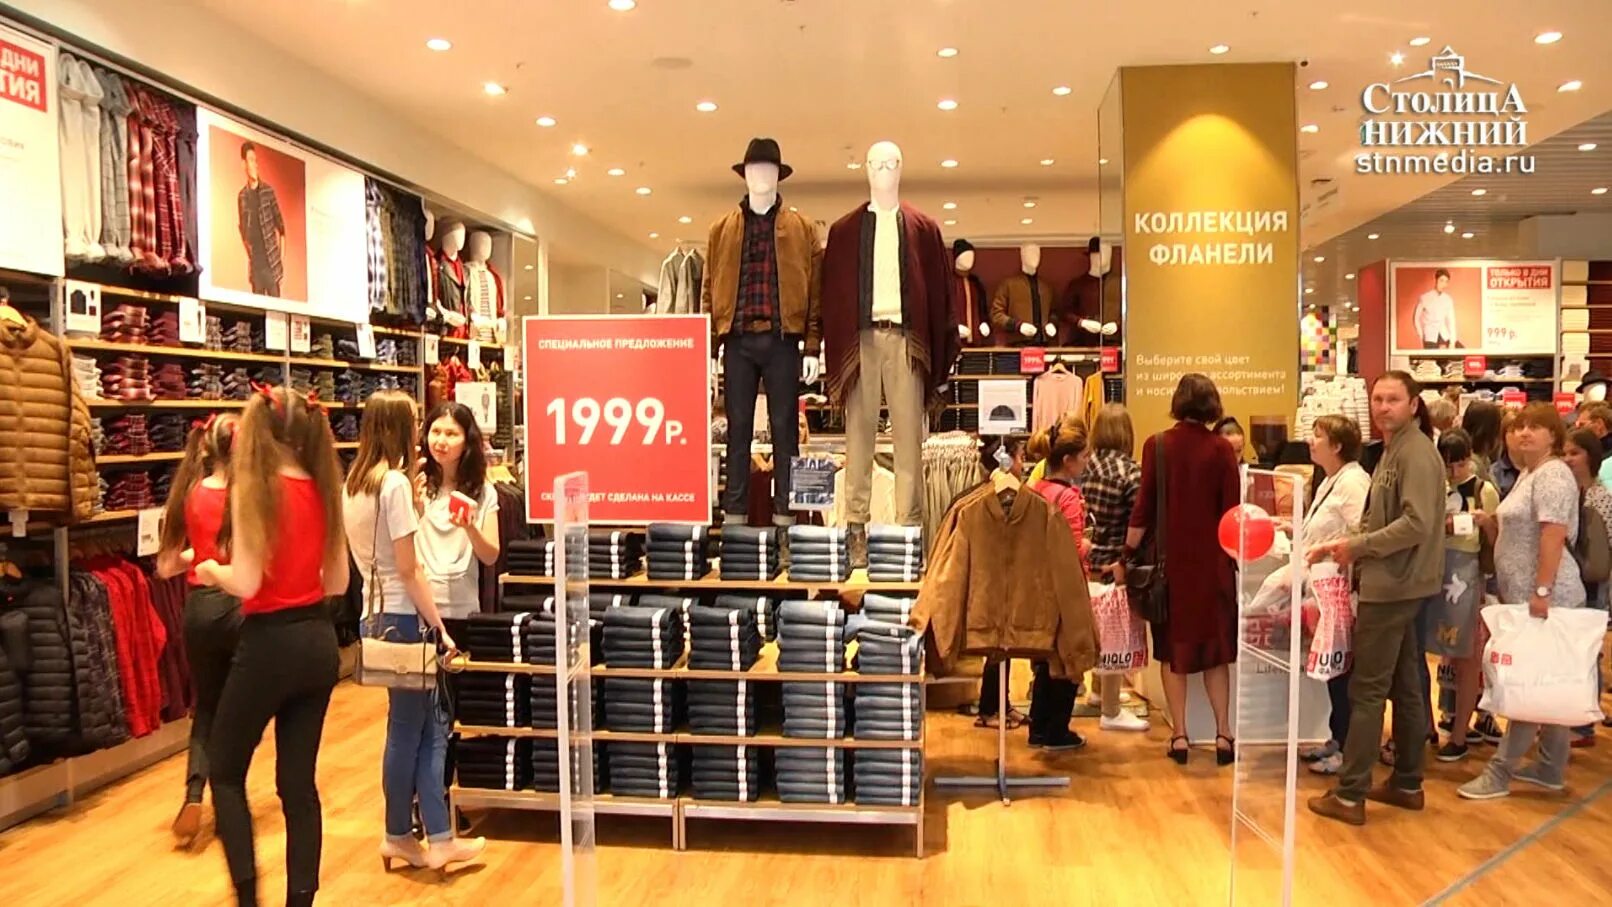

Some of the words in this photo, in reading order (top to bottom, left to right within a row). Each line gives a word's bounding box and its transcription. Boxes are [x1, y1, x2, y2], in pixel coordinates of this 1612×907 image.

[1, 47, 39, 77] ДНИ
[1135, 211, 1288, 236] КОЛЛЕКЦИЯ
[1149, 243, 1274, 266] ФЛАНЕЛИ
[1490, 277, 1549, 288] ОТКРЫТИЯ
[538, 338, 612, 350] СПЕЦИАЛЬНОЕ
[615, 338, 694, 350] ПРЕДЛОЖЕНИЕ
[1136, 354, 1192, 367] Выберите
[1195, 354, 1221, 365] свой
[1224, 355, 1250, 366] цвет
[1136, 372, 1149, 381] из
[1136, 387, 1144, 396] и
[607, 492, 650, 503] СДЕЛАНА
[652, 493, 664, 502] НА
[665, 493, 695, 503] КАССЕ
